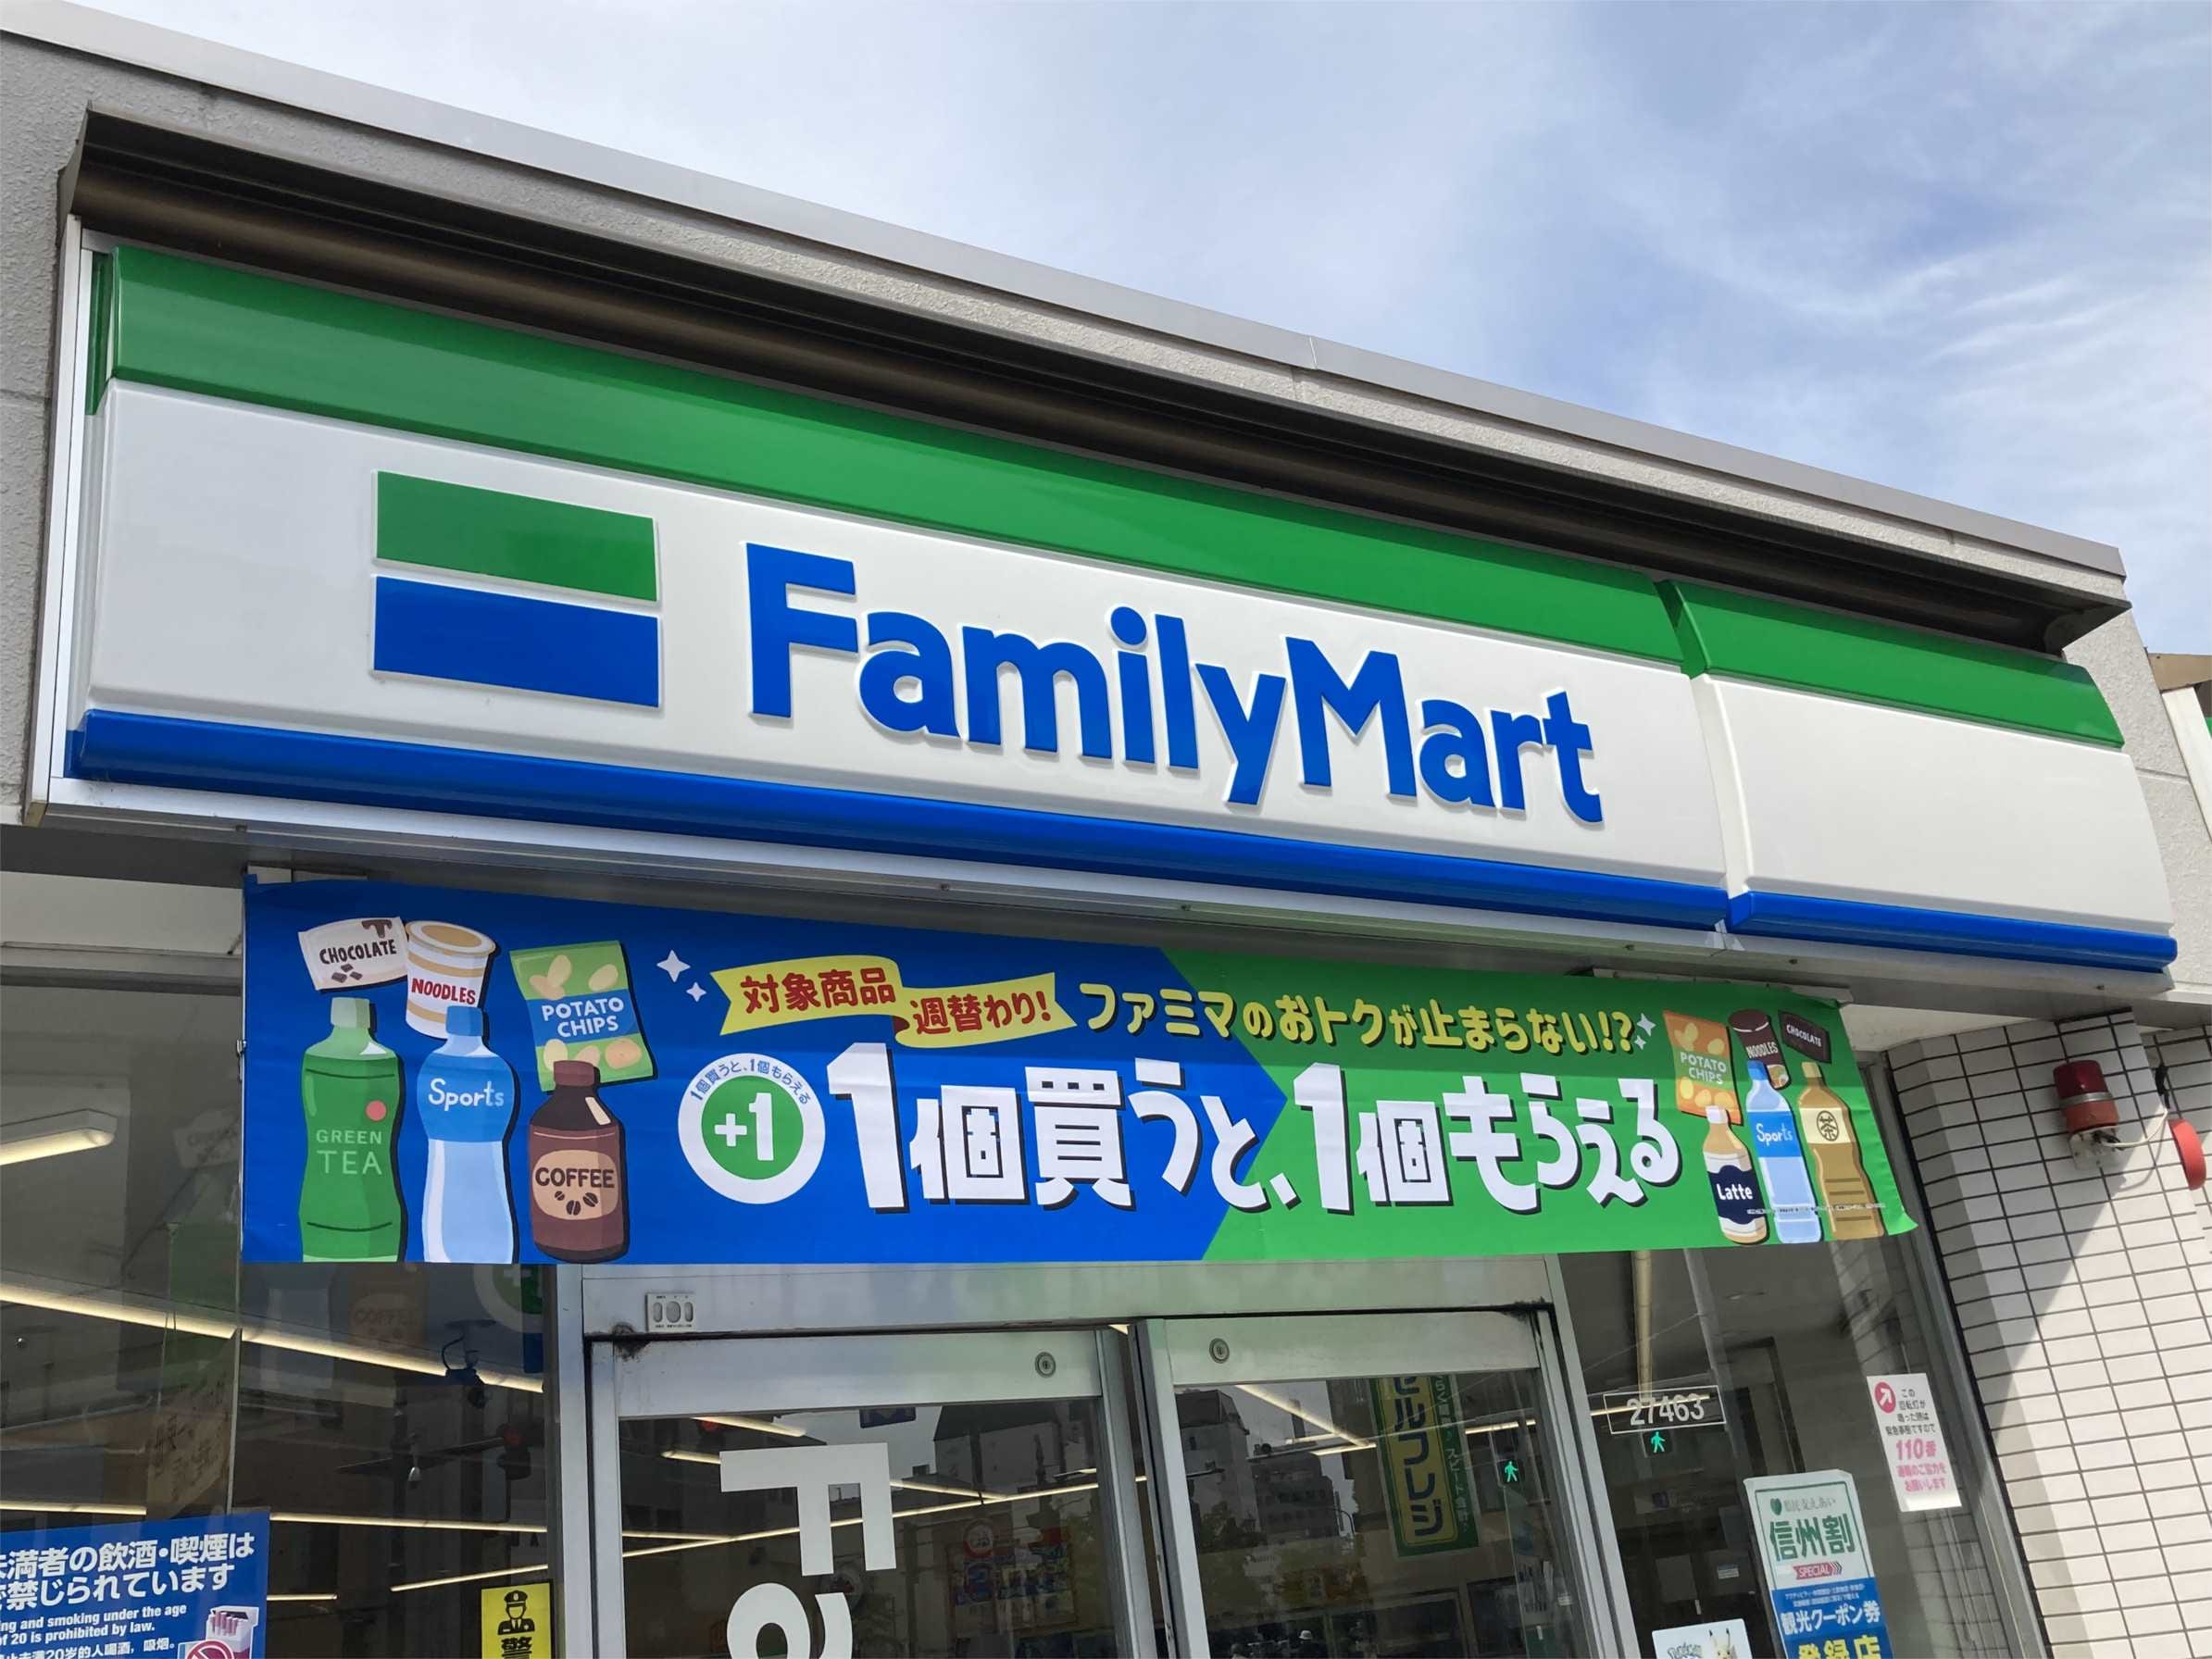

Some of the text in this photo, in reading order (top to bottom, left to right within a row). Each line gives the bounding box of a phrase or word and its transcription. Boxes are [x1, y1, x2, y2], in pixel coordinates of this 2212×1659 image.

[746, 543, 1604, 824] FamilyMart
[319, 939, 397, 965] CHOCOLATE
[411, 978, 476, 1004] NOODLES
[741, 967, 896, 1014] 対象商品
[542, 997, 624, 1021] POTATO
[556, 1016, 619, 1038] CHIPS
[1786, 1024, 1822, 1047] CHOCOLATE
[1745, 1042, 1779, 1058] NOODLES
[1680, 1052, 1727, 1073] POTATO
[1688, 1067, 1723, 1085] CHIPS
[429, 1078, 505, 1111] Sports
[316, 1129, 382, 1144] GREEN
[714, 1092, 774, 1161] +1
[1756, 1123, 1793, 1146] Sports
[317, 1150, 382, 1175] TEA
[535, 1166, 615, 1189] COFFEE
[1716, 1183, 1753, 1201] Latte
[1627, 1393, 1705, 1426] 27463
[1896, 1438, 1937, 1460] 110番
[1769, 1513, 1856, 1562] 信州割
[0, 1532, 255, 1579] 満者の飲酒・喫煙は
[1798, 1563, 1831, 1578] SPECIAL
[0, 1564, 235, 1611] 禁じられています
[0, 1604, 187, 1633] ng and smoking under the age
[1780, 1600, 1881, 1636] 観光クーポン券
[10, 1633, 28, 1645] 20
[31, 1631, 42, 1643] is
[44, 1625, 108, 1644] prohibited
[112, 1623, 127, 1637] by
[131, 1622, 156, 1633] law.
